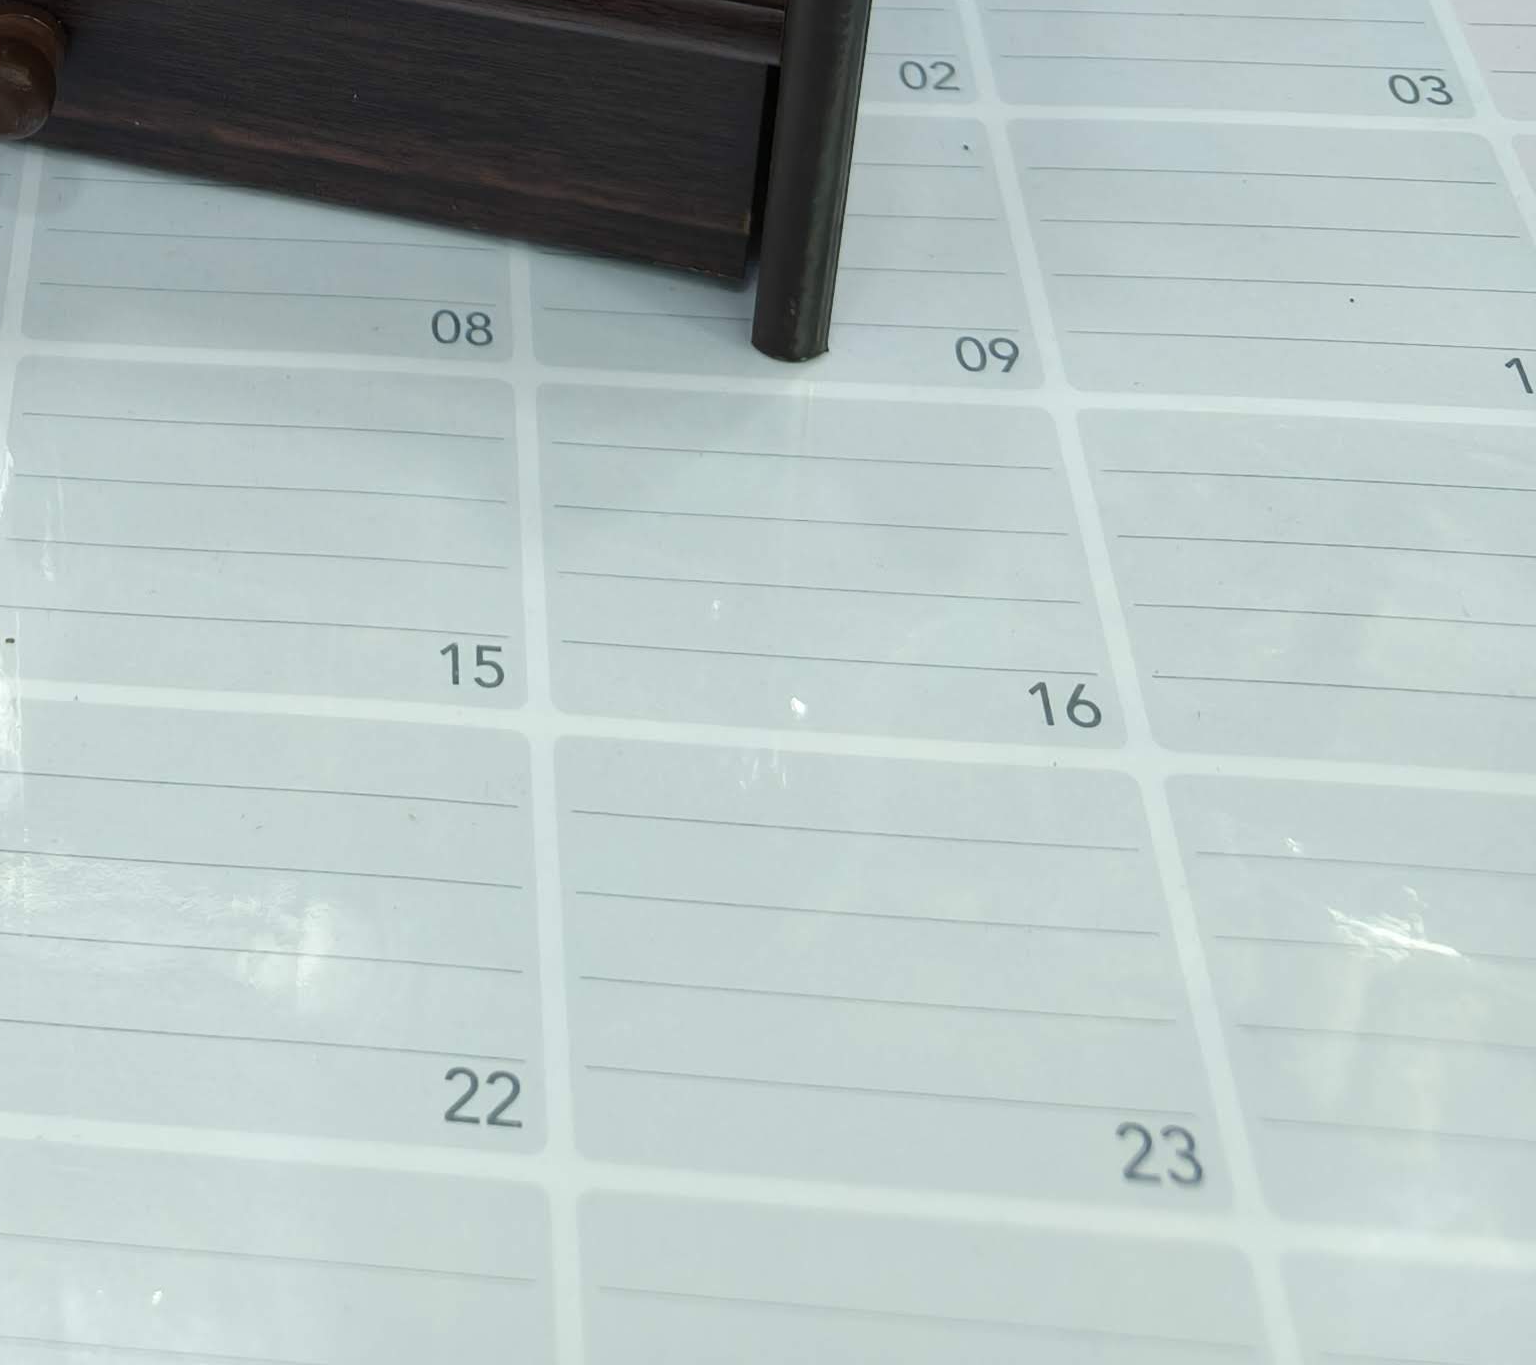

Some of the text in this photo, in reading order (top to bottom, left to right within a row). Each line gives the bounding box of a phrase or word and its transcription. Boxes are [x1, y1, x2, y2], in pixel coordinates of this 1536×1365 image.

[899, 61, 960, 91] 02
[1388, 74, 1454, 106] 03
[431, 309, 494, 347] 08
[955, 336, 1020, 373] 09
[440, 643, 505, 689] 15
[1028, 681, 1102, 729] 16
[443, 1066, 524, 1129] 22
[1115, 1122, 1204, 1186] 23
